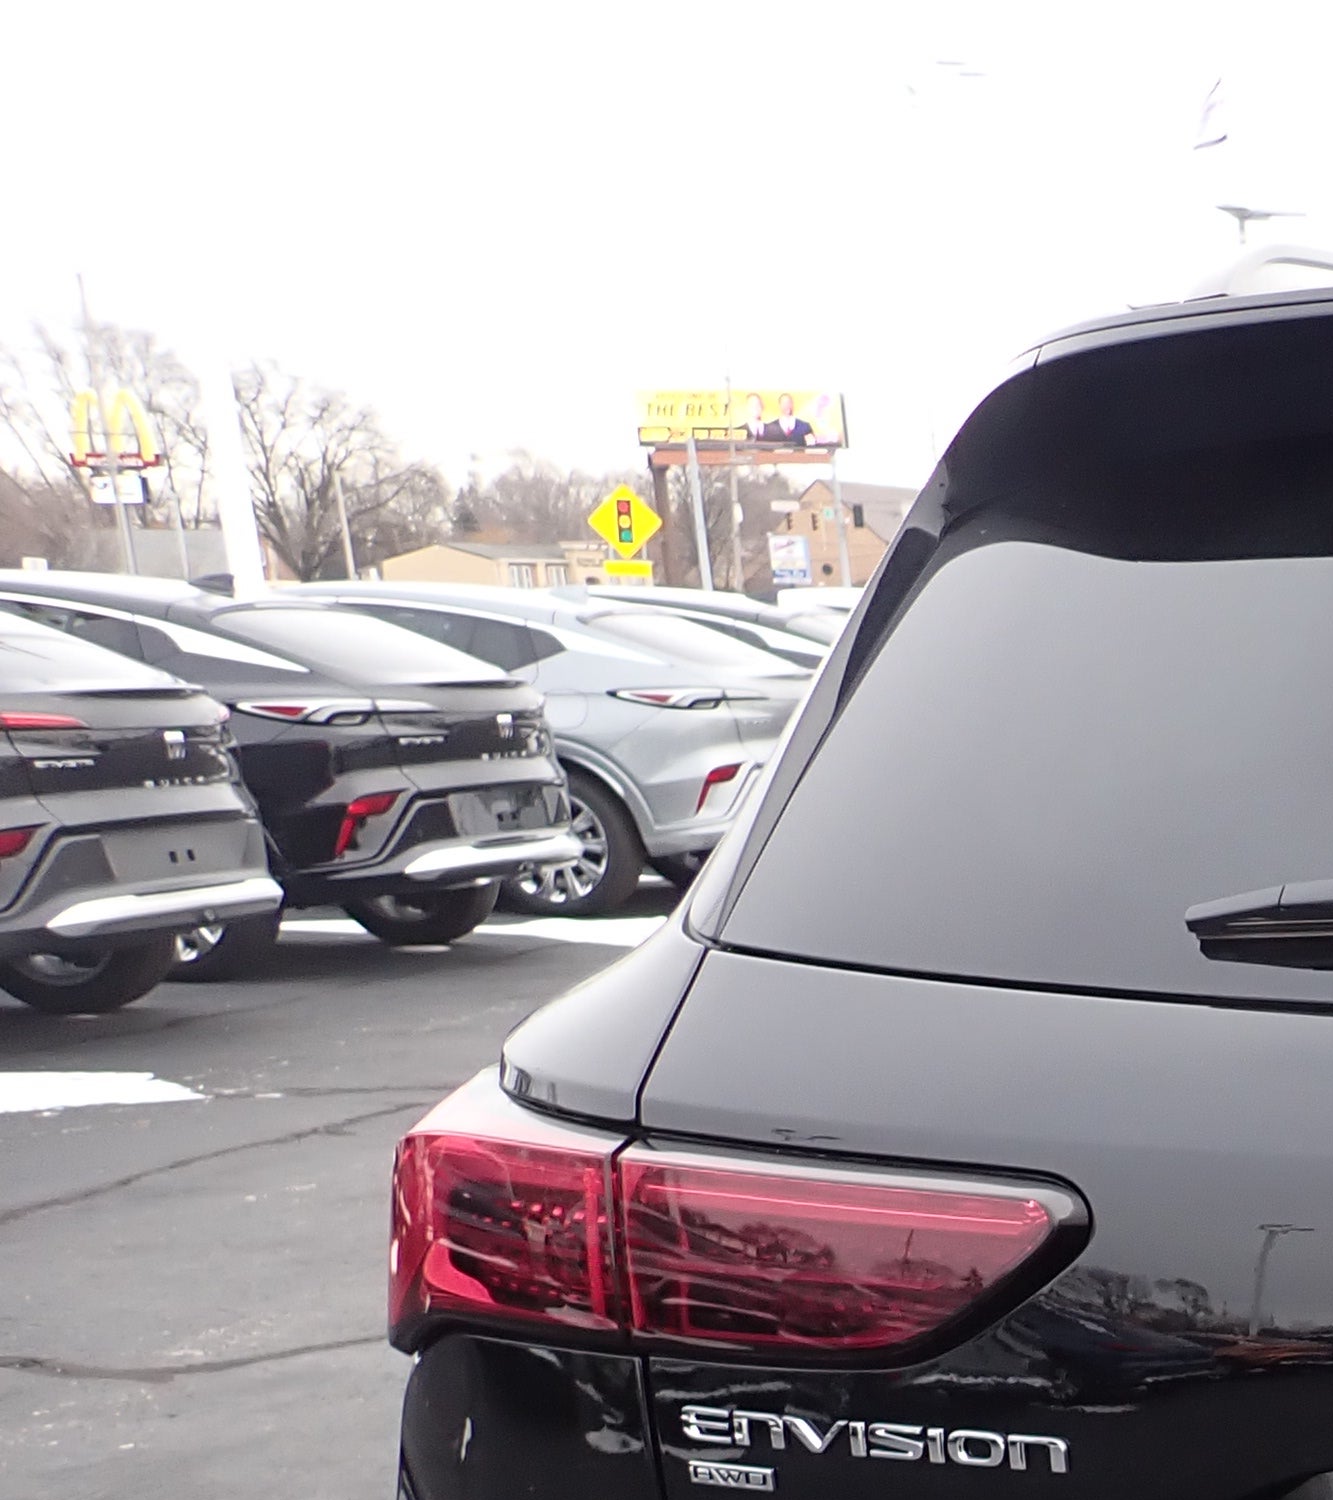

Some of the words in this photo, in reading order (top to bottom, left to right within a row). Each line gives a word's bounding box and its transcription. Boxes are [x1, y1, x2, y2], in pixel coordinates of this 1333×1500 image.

[685, 403, 729, 416] BEST
[681, 1404, 1069, 1474] ENVISION
[691, 1461, 774, 1489] AWD
